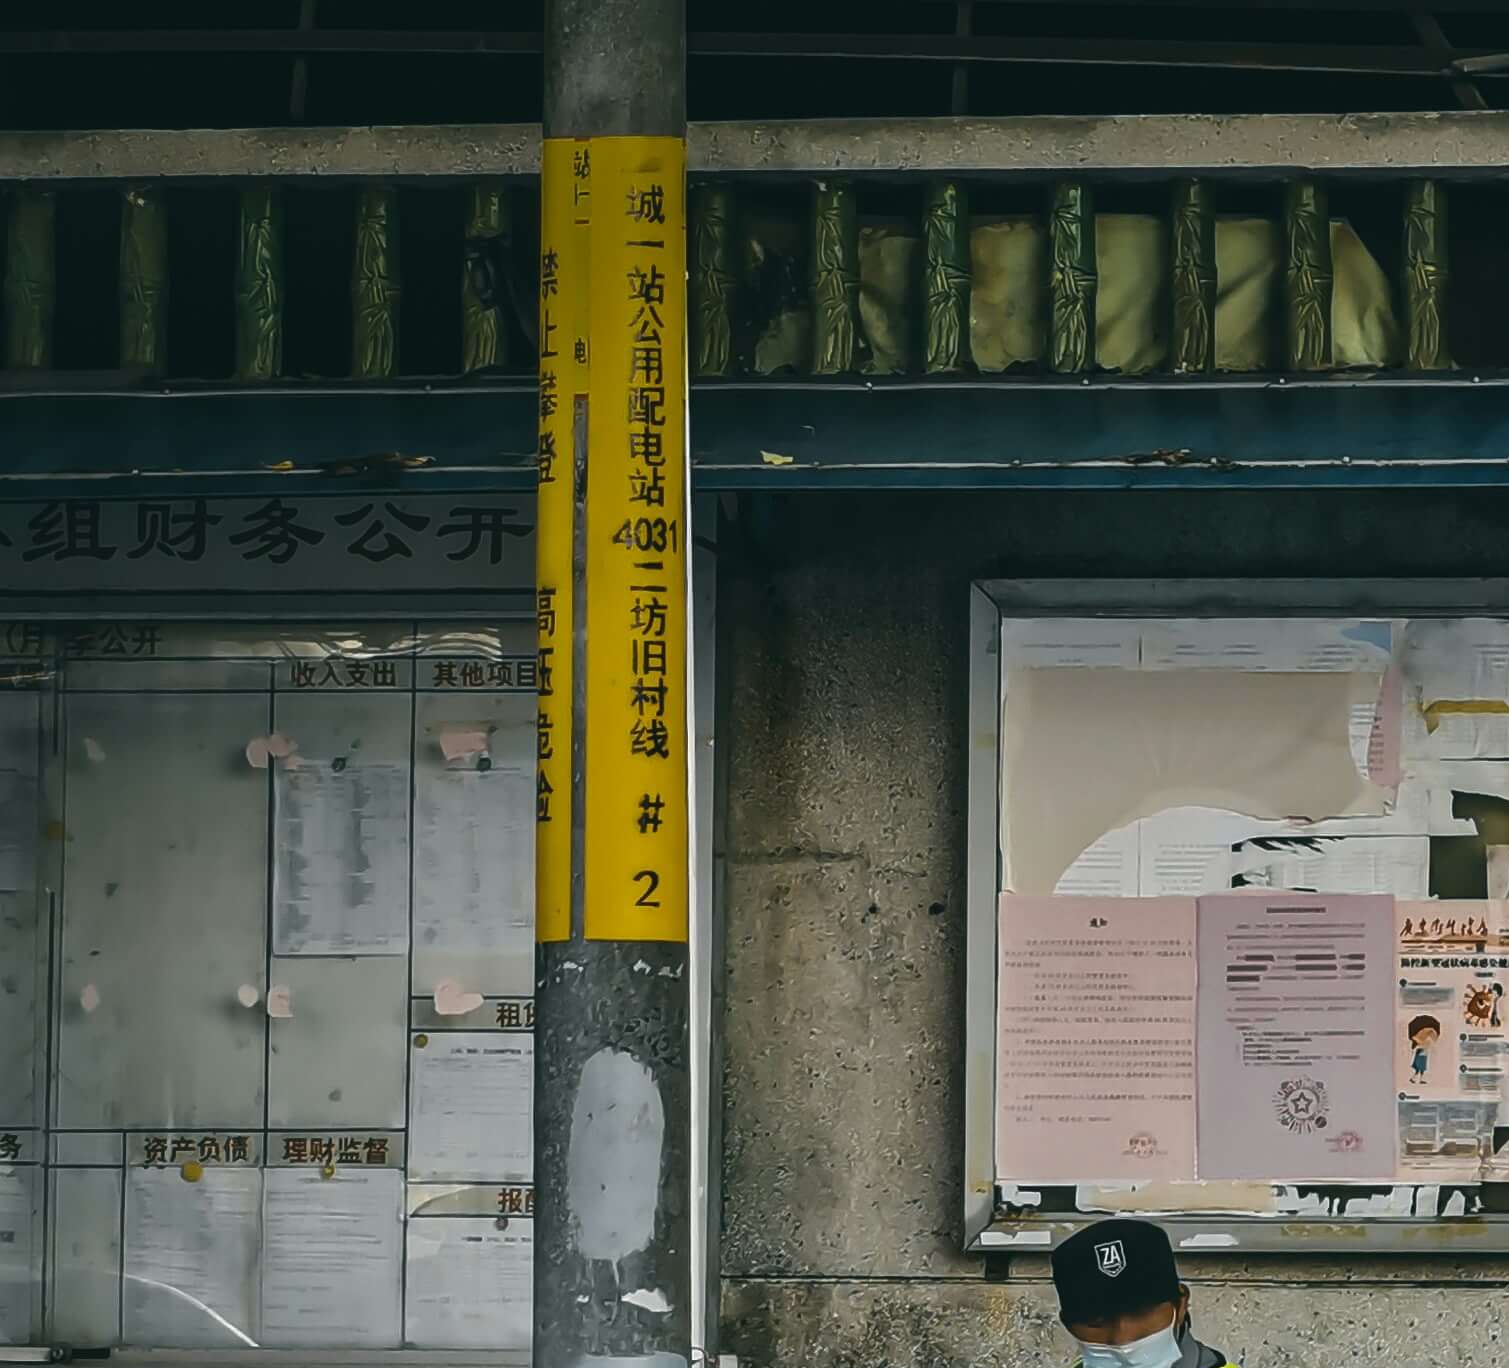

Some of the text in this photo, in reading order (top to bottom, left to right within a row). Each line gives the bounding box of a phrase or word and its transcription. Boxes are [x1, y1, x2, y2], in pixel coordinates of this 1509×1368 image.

[0, 500, 534, 564] 组财务公开
[290, 661, 397, 688] 收入支出
[432, 661, 537, 688] 其他项目
[143, 1136, 250, 1163] 资产负债
[281, 1137, 389, 1165] 理财监督
